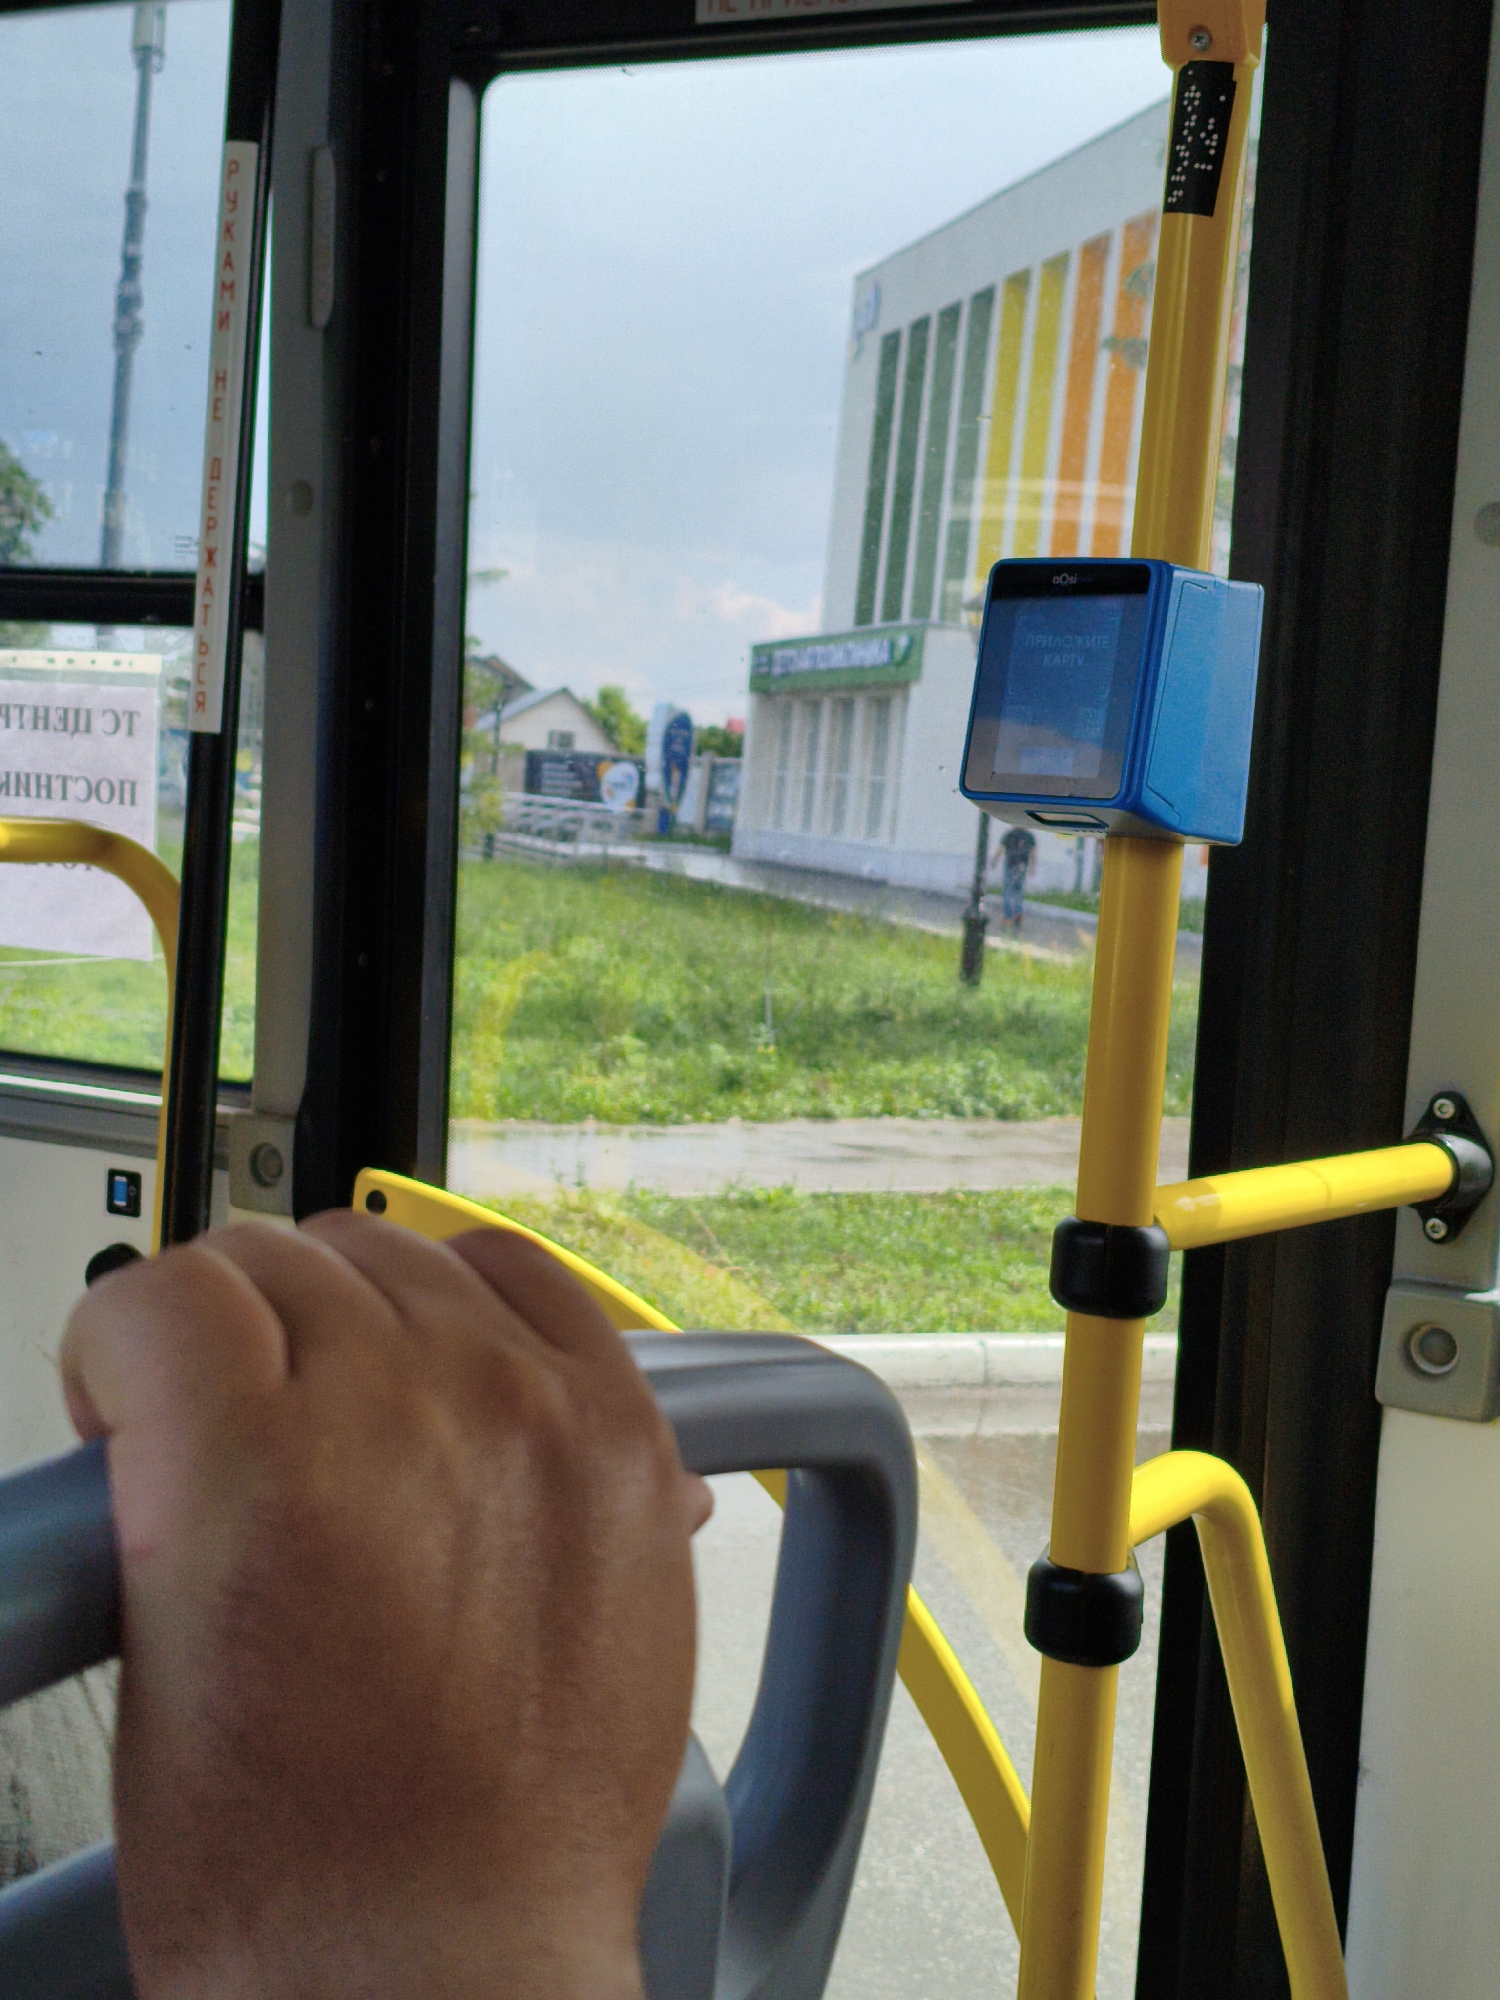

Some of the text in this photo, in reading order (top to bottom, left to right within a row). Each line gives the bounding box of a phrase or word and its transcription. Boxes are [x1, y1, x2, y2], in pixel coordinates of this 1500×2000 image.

[195, 159, 241, 713] РУКАМИ НЕ ДЕРЖАТЬСЯ
[1025, 633, 1110, 650] ПРИЛОЖИТЕ
[1043, 653, 1084, 667] КАРТУ
